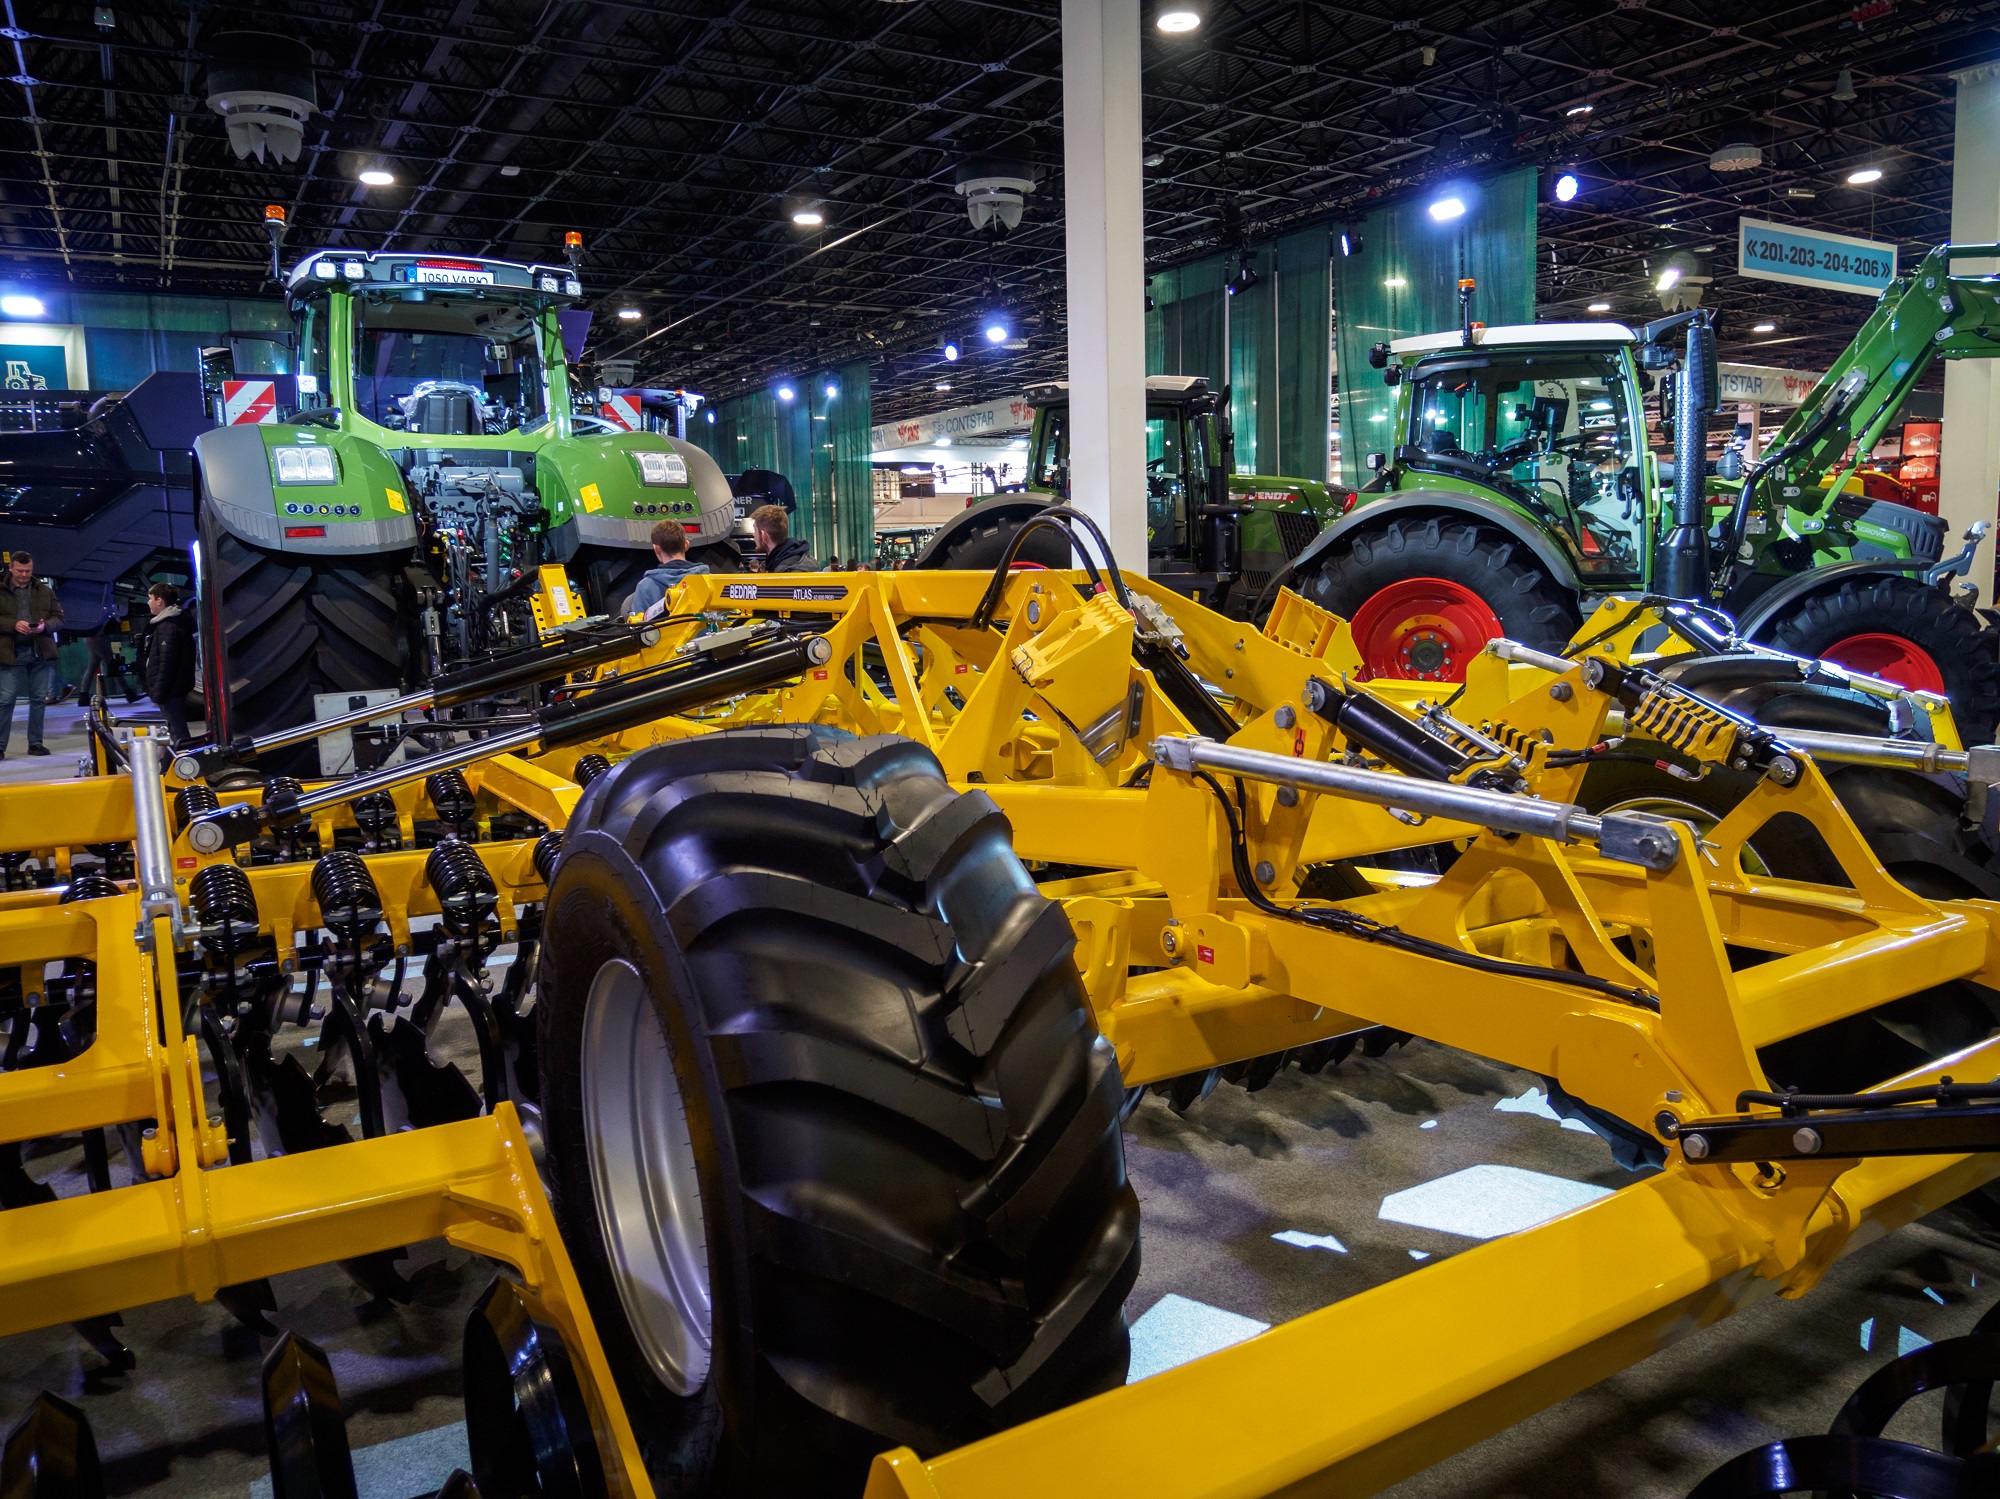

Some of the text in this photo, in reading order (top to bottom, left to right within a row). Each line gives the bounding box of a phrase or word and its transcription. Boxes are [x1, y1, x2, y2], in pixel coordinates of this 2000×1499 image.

[423, 272, 449, 283] 1050
[945, 410, 995, 434] CONTSTAR
[1855, 525, 1899, 542] AGROVARIO
[729, 584, 758, 600] BEDNAR
[792, 588, 813, 600] ATLAS
